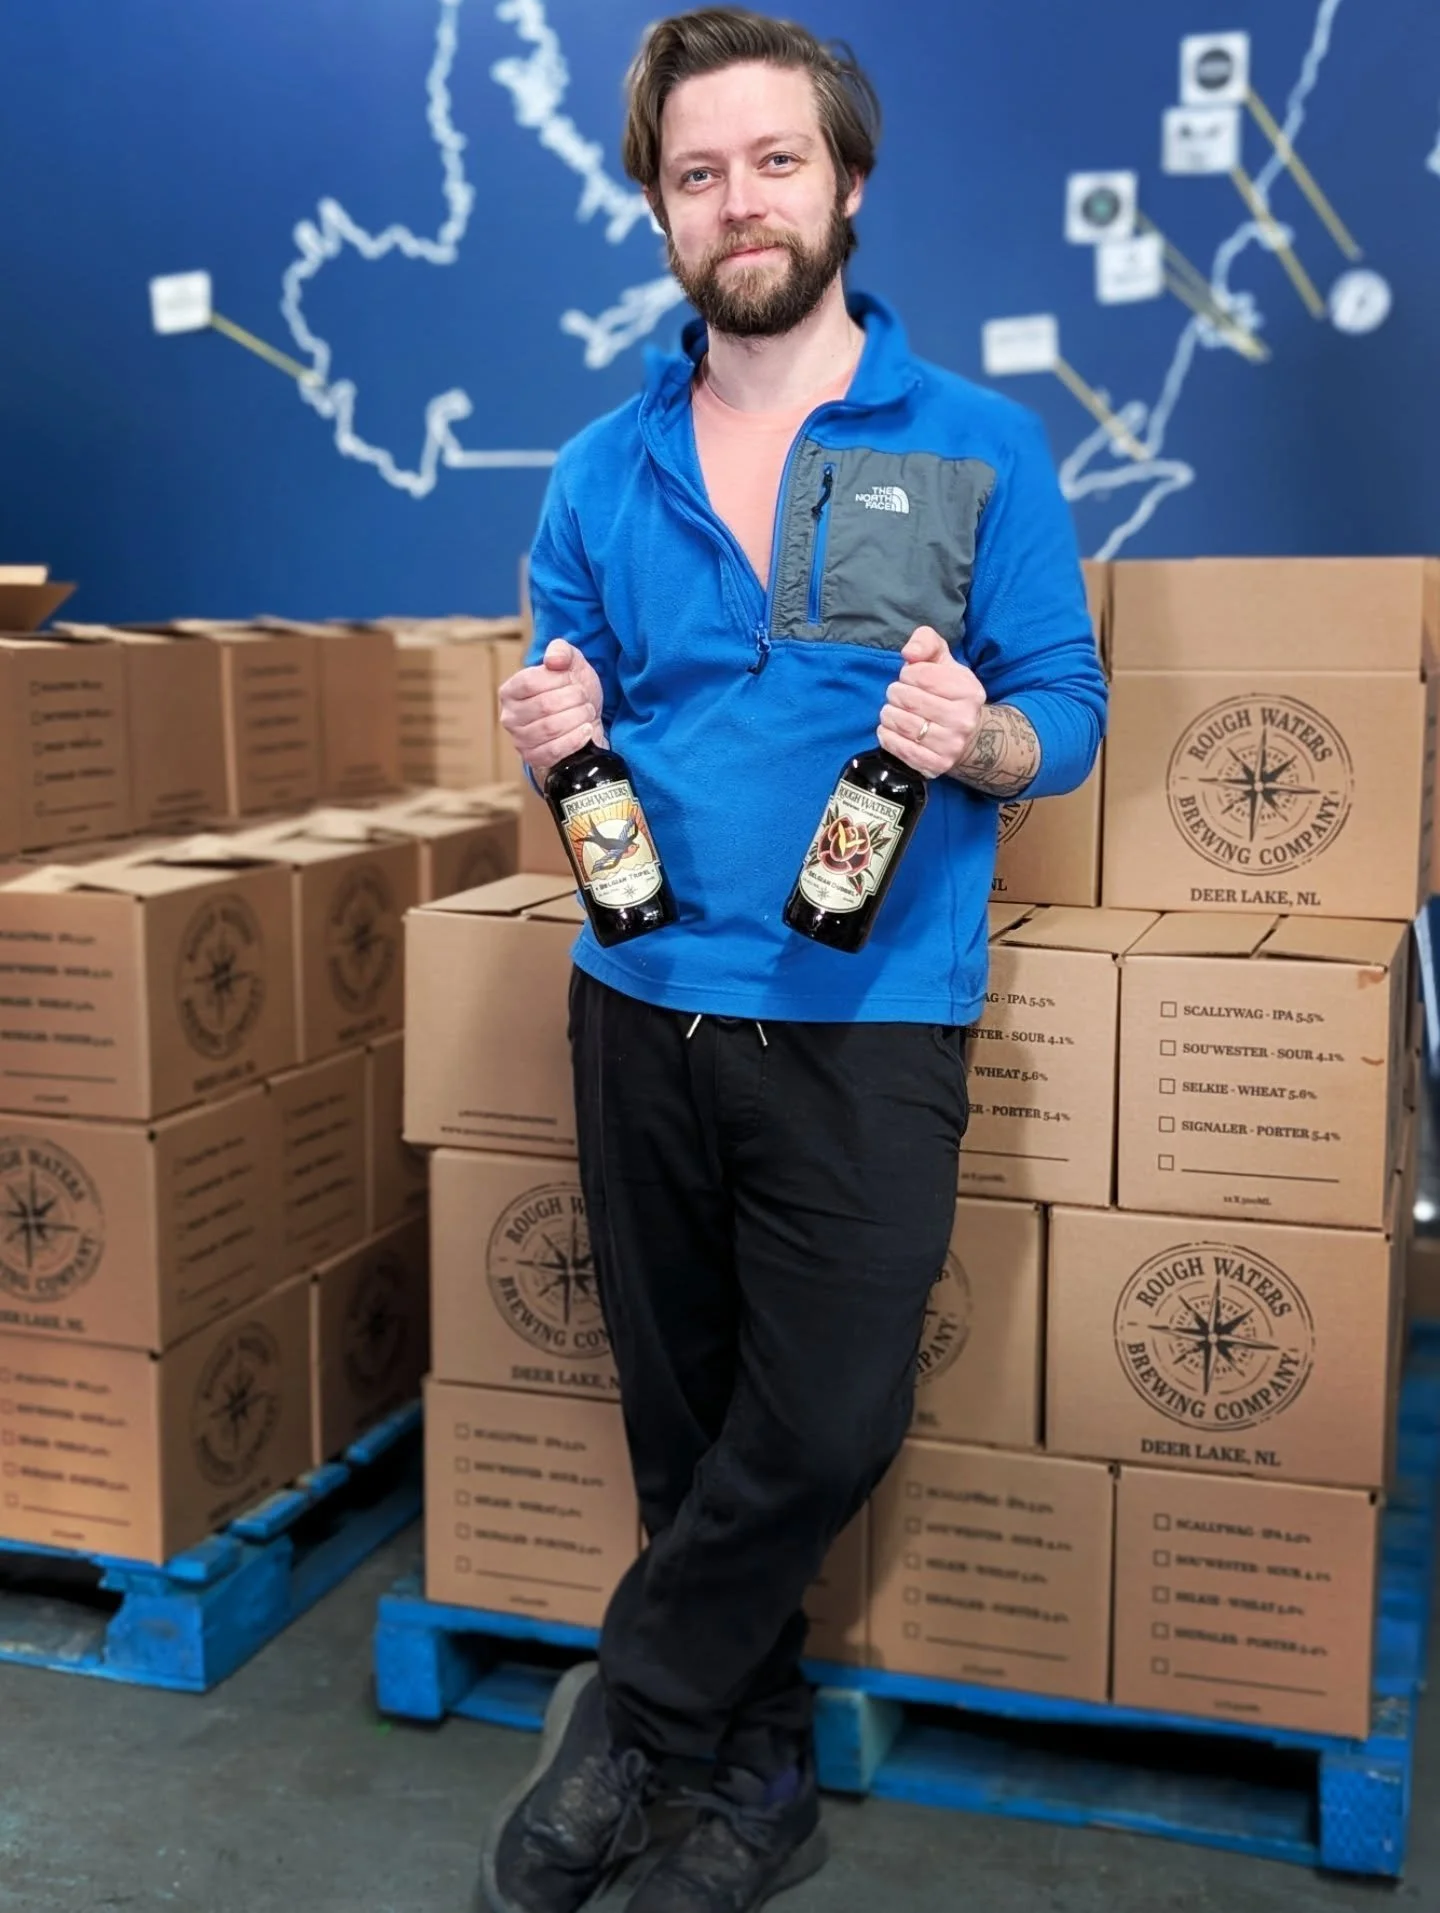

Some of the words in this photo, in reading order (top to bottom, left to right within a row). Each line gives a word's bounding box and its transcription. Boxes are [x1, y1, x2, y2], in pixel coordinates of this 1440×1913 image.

[855, 494, 893, 503] NORTH
[872, 486, 893, 495] THE
[865, 502, 892, 511] FACE
[1188, 708, 1252, 761] ROUGH
[1260, 707, 1333, 763] WATERS
[566, 796, 595, 813] ROUGH
[595, 785, 629, 804] WATERS
[860, 794, 898, 820] WATERS
[1179, 795, 1251, 865] BREWING
[1259, 795, 1340, 866] COMPANY
[600, 877, 627, 891] BELGIAN
[808, 870, 832, 886] BELGIAN
[1190, 888, 1239, 904] DEER
[1241, 889, 1294, 907] LAKE,
[1296, 892, 1321, 906] NL
[1007, 993, 1028, 1005] IPA
[1028, 996, 1056, 1008] 5.5%
[1184, 1005, 1264, 1019] SCALLYWAG
[1272, 1009, 1294, 1021] IPA
[1295, 1012, 1325, 1024] 5.5%
[1011, 1031, 1046, 1043] SOUR
[1047, 1036, 1075, 1045] 4.1%
[1183, 1043, 1268, 1058] SOU'WESTER
[1276, 1048, 1314, 1061] SOUR
[1315, 1050, 1345, 1062] 4.1%
[974, 1066, 1020, 1080] WHEAT
[1021, 1071, 1049, 1082] 5.6%
[1182, 1081, 1229, 1095] SELKIE
[1238, 1085, 1287, 1099] WHEAT
[992, 1105, 1041, 1119] PORTER
[1042, 1111, 1071, 1122] 5.4%
[1181, 1120, 1248, 1135] SIGNALER
[1256, 1126, 1309, 1140] PORTER
[1311, 1130, 1341, 1142] 5.4%
[505, 1196, 563, 1244] ROUGH
[1136, 1257, 1205, 1308] ROUGH
[1213, 1257, 1293, 1318] WATERS
[498, 1277, 566, 1346] BREWING
[1127, 1342, 1206, 1419] BREWING
[1214, 1352, 1300, 1421] COMPANY
[1141, 1439, 1192, 1458] DEER
[1195, 1444, 1252, 1465] LAKE,
[1255, 1451, 1282, 1467] NL
